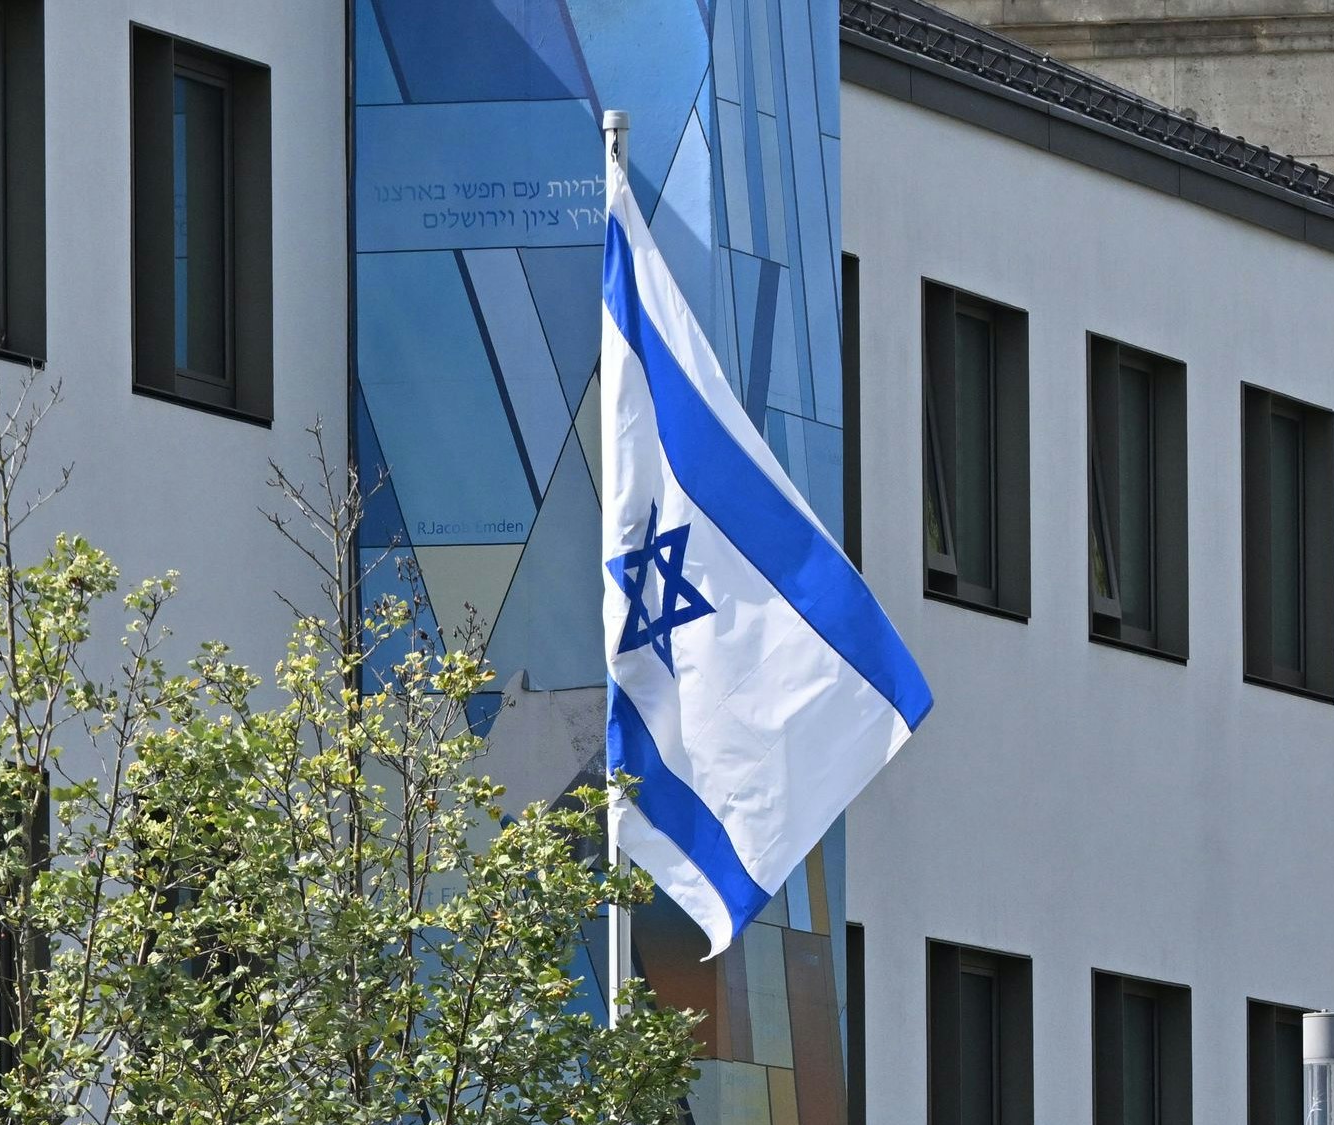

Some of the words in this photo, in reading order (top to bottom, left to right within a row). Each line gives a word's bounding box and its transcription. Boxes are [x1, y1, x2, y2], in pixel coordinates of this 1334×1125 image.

[453, 181, 506, 199] חפשי
[513, 181, 540, 199] עם
[423, 208, 514, 229] וירושלים
[523, 209, 559, 232] ציון
